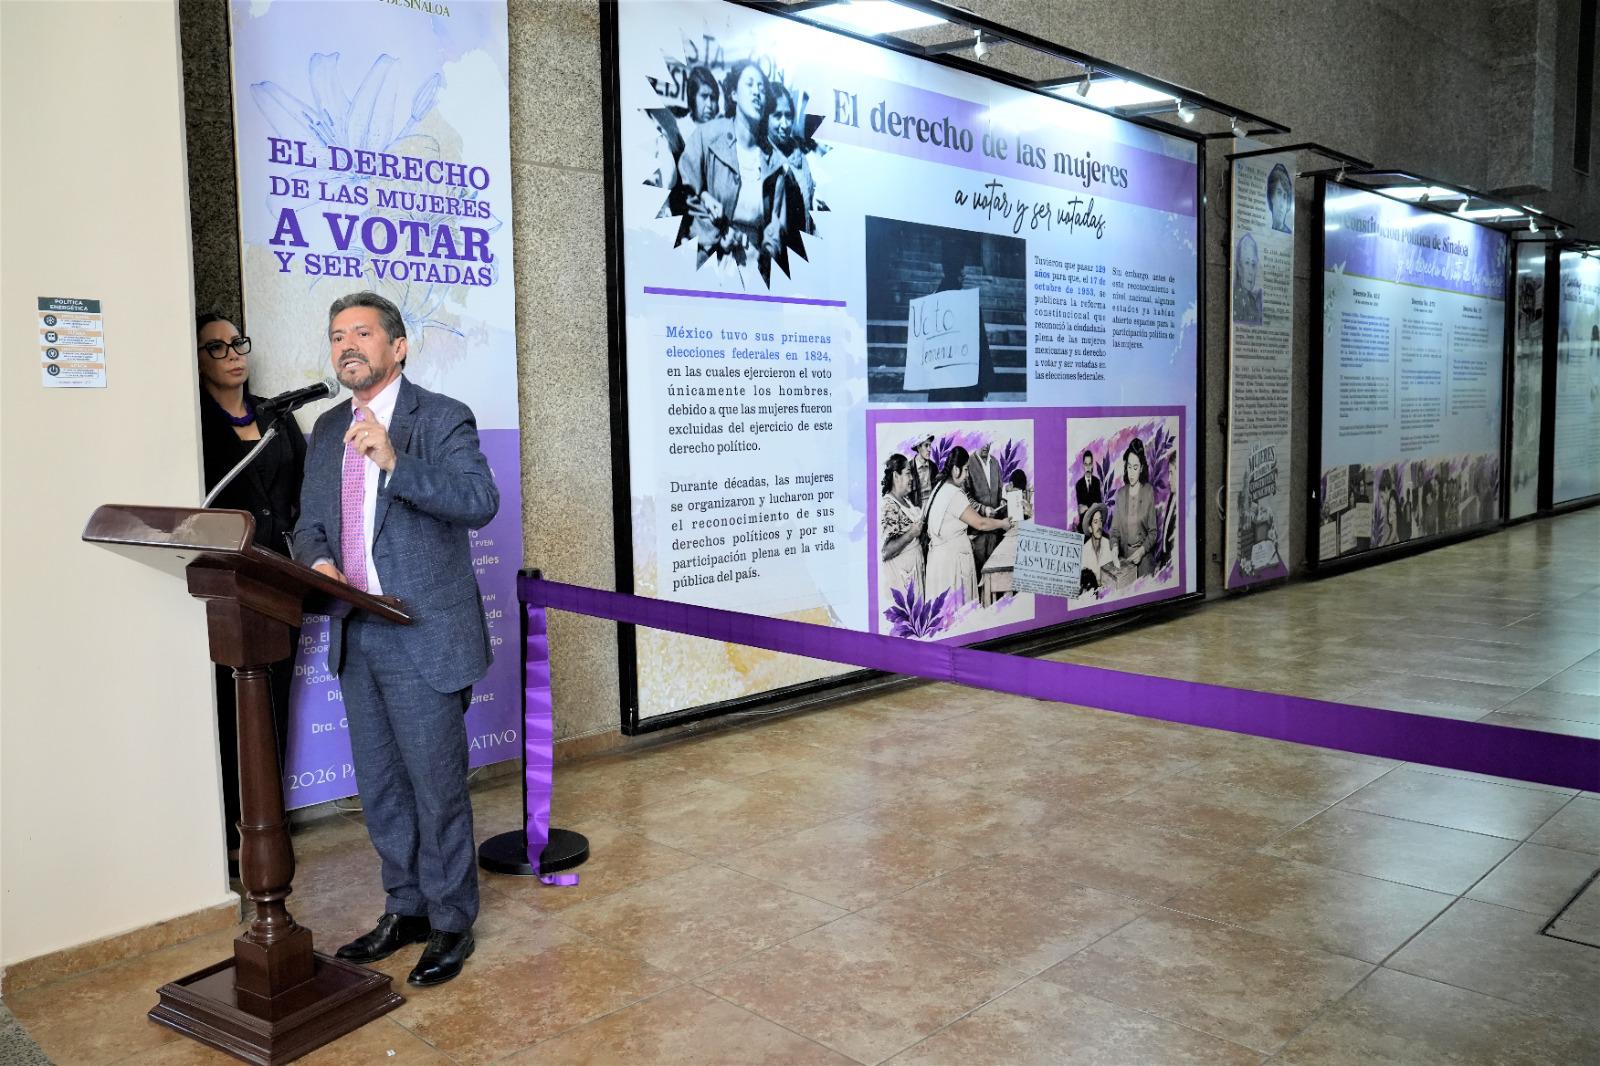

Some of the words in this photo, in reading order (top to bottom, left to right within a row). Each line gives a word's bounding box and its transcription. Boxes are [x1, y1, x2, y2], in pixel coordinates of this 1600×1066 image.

[833, 88, 860, 128] El
[870, 101, 974, 152] derecho
[982, 126, 1008, 160] de
[1016, 135, 1046, 170] las
[1054, 150, 1128, 189] mujeres
[268, 137, 317, 168] EL
[328, 146, 490, 190] DERECHO
[270, 176, 309, 198] DE
[319, 181, 368, 205] LAS
[377, 188, 490, 219] MUJERES
[955, 188, 968, 205] a
[973, 179, 1012, 220] votar
[1014, 199, 1028, 233] y
[1032, 202, 1050, 231] ser
[1057, 196, 1106, 239] votadas
[269, 208, 309, 247] A
[323, 212, 494, 263] VOTAR
[274, 251, 295, 273] Y
[305, 254, 363, 277] SER
[371, 258, 492, 286] VOTADAS
[1034, 284, 1061, 292] octubre
[666, 326, 713, 339] México
[721, 329, 748, 341] tuvo
[755, 331, 774, 342] sus
[781, 334, 832, 345] primeras
[666, 347, 725, 359] elecciones
[732, 347, 780, 360] federales
[786, 352, 798, 360] en
[805, 351, 831, 362] 1824,
[667, 367, 681, 377] en
[685, 366, 701, 377] las
[706, 367, 740, 378] cuales
[744, 367, 796, 380] ejercieron
[799, 368, 808, 378] el
[812, 369, 832, 379] voto
[668, 384, 745, 396] únicamente
[754, 385, 771, 396] los
[779, 386, 832, 397] hombres,
[668, 404, 707, 415] debido
[709, 407, 716, 415] a
[718, 406, 738, 417] que
[741, 404, 756, 414] las
[758, 404, 798, 416] mujeres
[801, 403, 832, 413] fueron
[669, 423, 723, 435] excluidas
[728, 422, 744, 433] del
[750, 421, 793, 433] ejercicio
[797, 420, 809, 431] de
[814, 421, 833, 431] este
[669, 442, 715, 455] derecho
[717, 441, 761, 455] político.
[671, 480, 718, 493] Durante
[724, 476, 769, 489] décadas,
[775, 474, 789, 486] las
[796, 473, 834, 486] mujeres
[671, 502, 683, 512] se
[688, 495, 755, 513] organizaron
[759, 496, 765, 507] y
[770, 492, 814, 504] lucharon
[818, 490, 835, 502] por
[671, 520, 683, 531] el
[692, 511, 789, 530] reconocimiento
[797, 508, 809, 519] de
[816, 507, 835, 517] sus
[672, 536, 725, 550] derechos
[733, 528, 780, 547] políticos
[786, 528, 793, 540] y
[800, 525, 817, 538] por
[823, 524, 835, 533] su
[673, 550, 746, 572] participación
[752, 547, 780, 562] plena
[785, 546, 796, 556] en
[802, 543, 810, 554] la
[815, 540, 835, 551] vida
[1015, 554, 1034, 567] LAS
[1044, 542, 1080, 559] VOTEN
[673, 575, 715, 592] pública
[717, 570, 733, 583] del
[735, 567, 760, 583] país.
[296, 664, 318, 676] Dip.
[312, 723, 335, 734] Dra.
[288, 764, 336, 790] 2026
